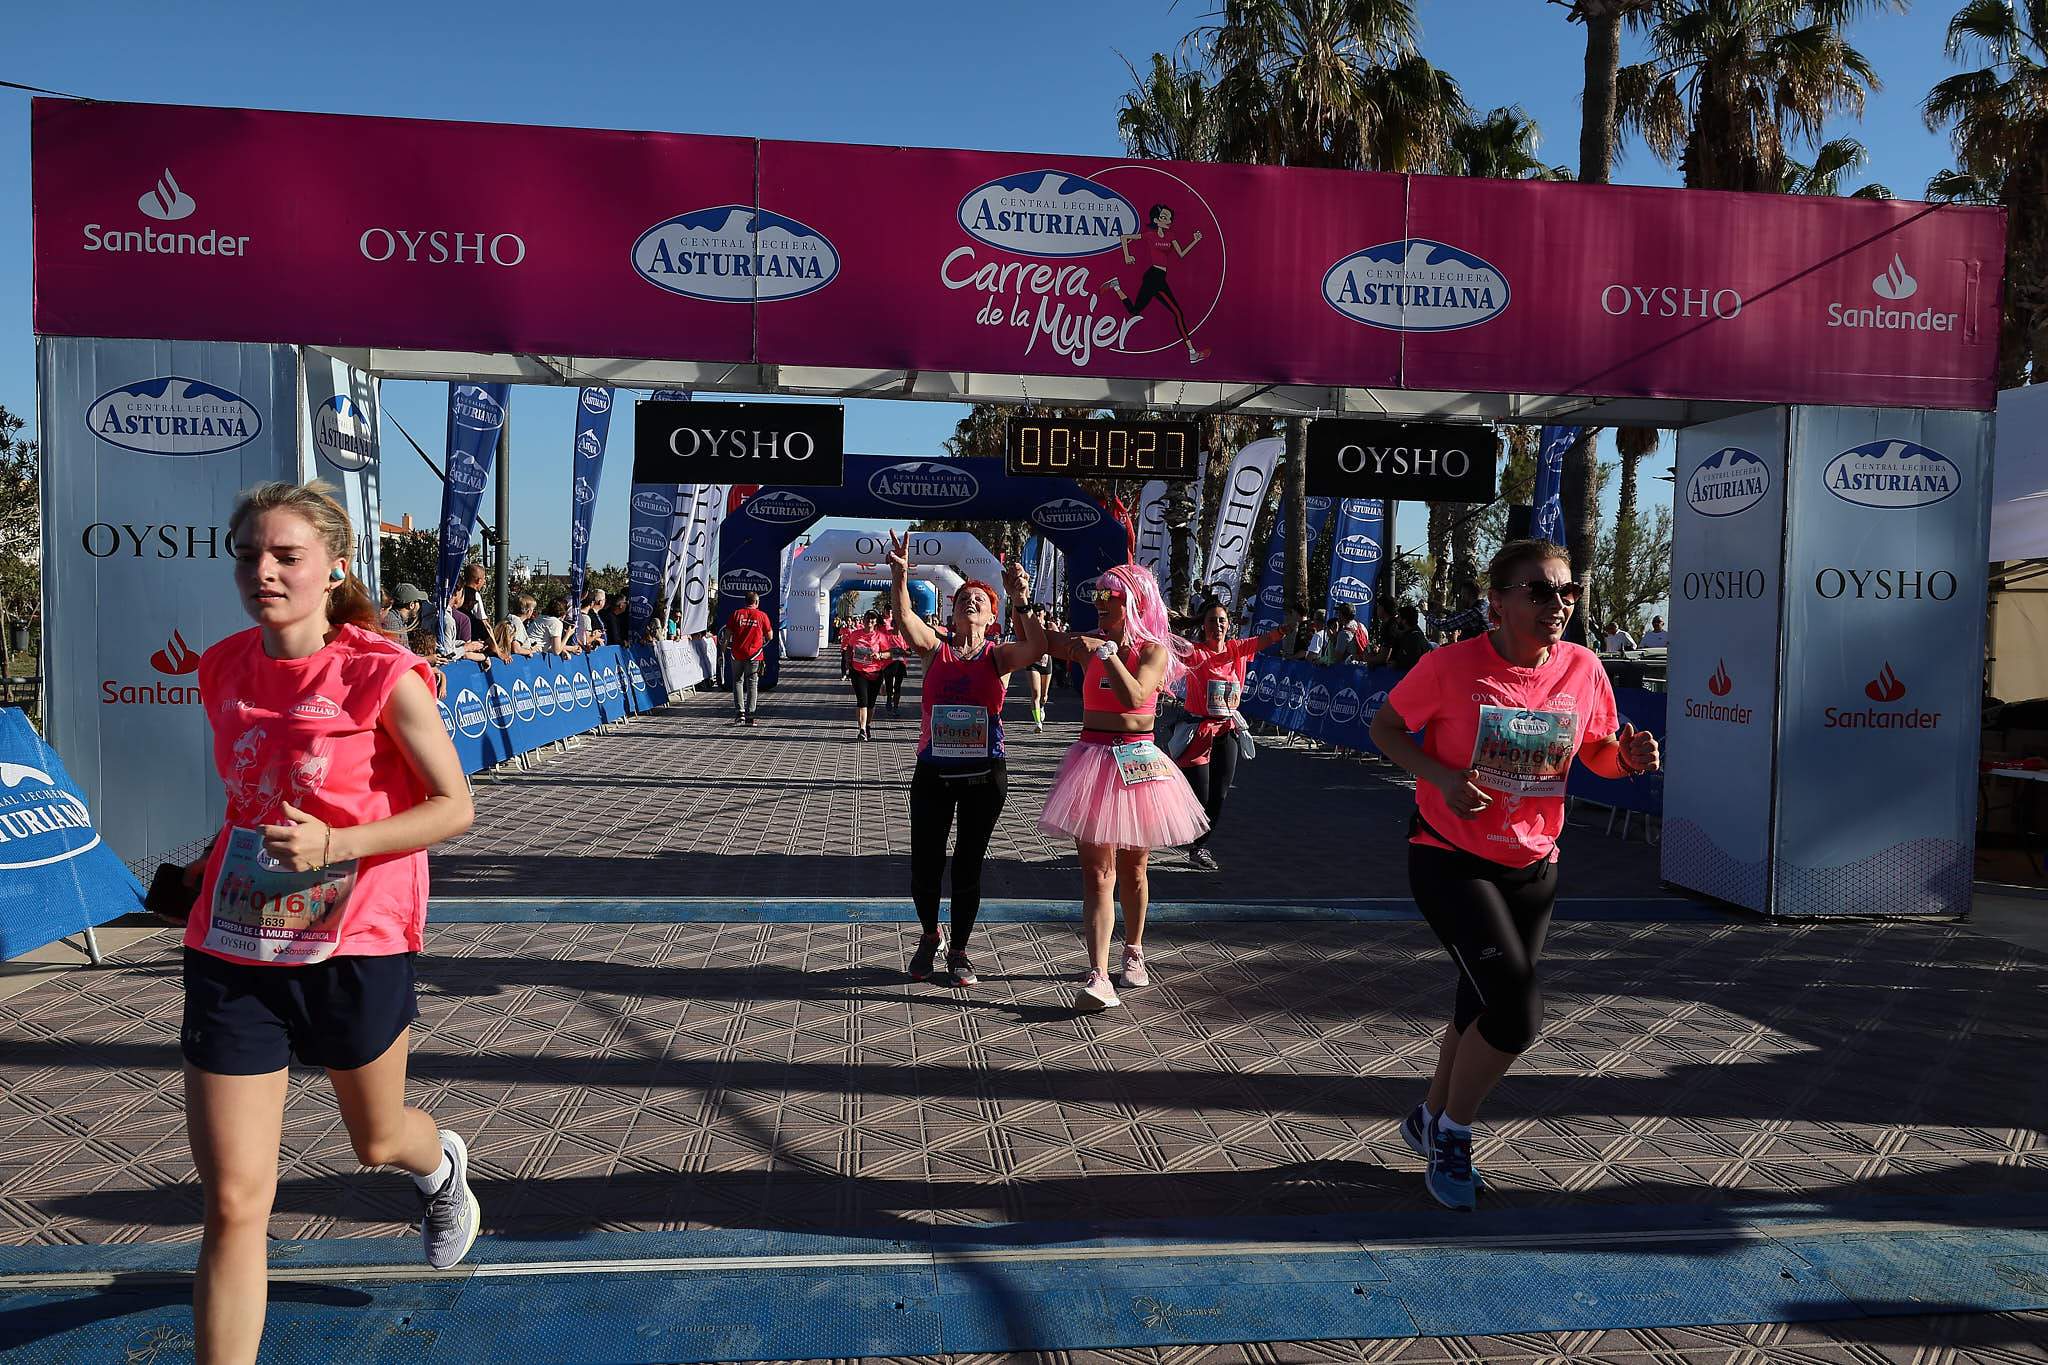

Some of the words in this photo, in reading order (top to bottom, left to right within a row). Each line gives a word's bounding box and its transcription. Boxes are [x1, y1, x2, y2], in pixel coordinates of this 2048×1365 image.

[971, 198, 1124, 237] ASTURIANA
[1000, 197, 1057, 209] CENTRAL
[1062, 201, 1120, 212] LECHERA
[83, 223, 250, 257] Santander
[359, 227, 526, 266] OYSHO
[680, 237, 745, 248] CENTRAL
[648, 238, 824, 279] ASTURIANA
[940, 246, 1090, 297] Carrera
[1336, 269, 1496, 310] ASTURIANA
[1366, 269, 1425, 280] CENTRAL
[1431, 271, 1491, 283] LECHERA
[1601, 284, 1742, 320] OYSHO
[1827, 302, 1957, 333] Santander
[976, 295, 1004, 326] de
[1010, 295, 1030, 328] la
[1025, 294, 1144, 367] Mujer
[100, 404, 249, 438] ASTURIANA
[127, 403, 184, 414] CENTRAL
[187, 404, 244, 414] LECHERA
[669, 427, 815, 461] OYSHO
[1021, 427, 1184, 469] 00:40:27
[1337, 444, 1470, 478] OYSHO
[1854, 462, 1898, 471] CENTRAL
[1901, 463, 1947, 473] LECHERA
[876, 474, 971, 497] ASTURIANA
[1690, 474, 1764, 504] ASTURIANA
[1832, 462, 1951, 493] ASTURIANA
[750, 502, 810, 517] ASTURIANA
[1036, 510, 1097, 523] ASTURIANA
[855, 537, 942, 557] OYHO
[1207, 465, 1264, 608] OYSHO
[803, 555, 830, 563] OYSHO
[1683, 568, 1765, 601] OYSHO
[1815, 568, 1958, 601] OYSHO
[1684, 698, 1753, 725] Santander
[1824, 706, 1942, 729] Santander
[217, 918, 243, 934] CARRERA
[243, 926, 254, 935] DE
[254, 928, 264, 937] LA
[266, 929, 294, 939] MUJER
[259, 916, 285, 928] 3639
[220, 934, 256, 952] OYSHO
